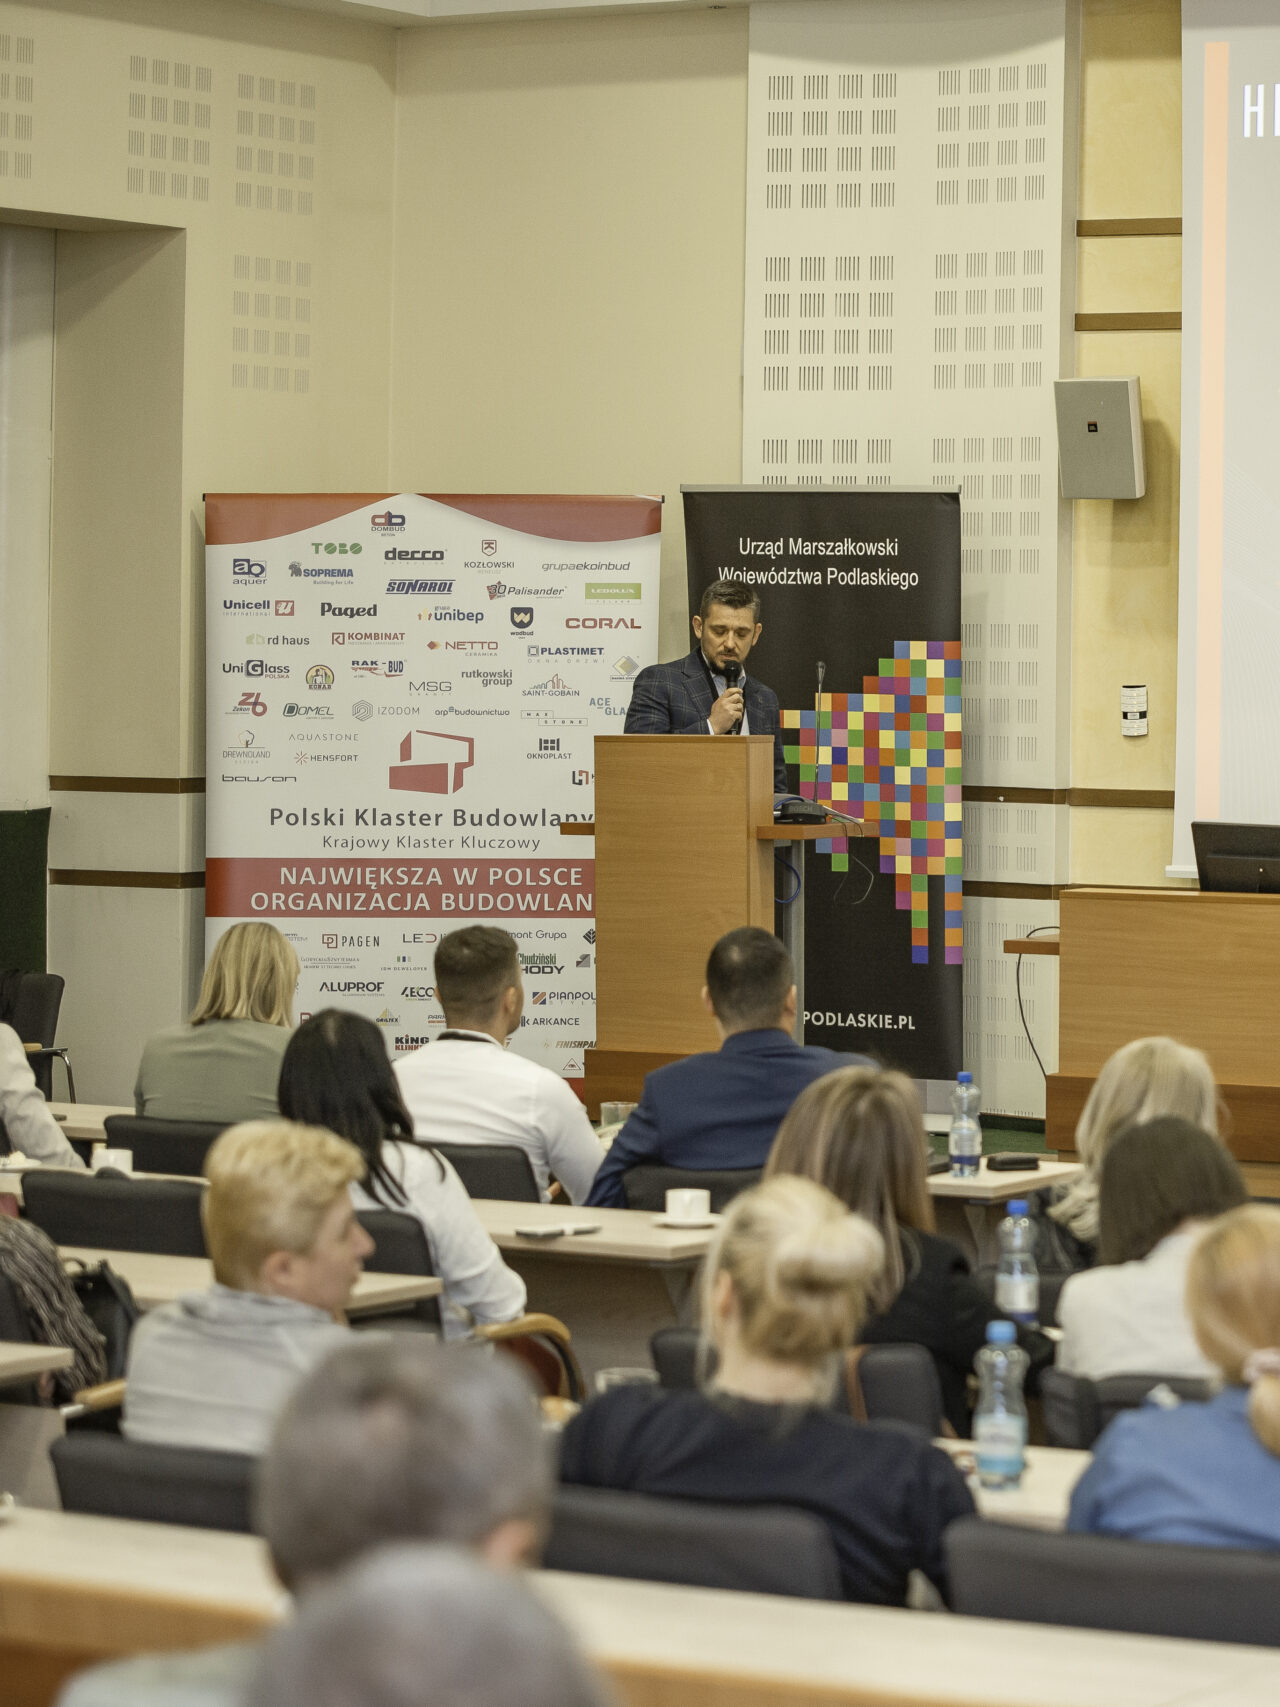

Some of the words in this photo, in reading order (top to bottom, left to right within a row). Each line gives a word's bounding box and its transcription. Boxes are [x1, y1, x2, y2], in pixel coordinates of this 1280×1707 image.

[311, 542, 363, 555] TOBO
[739, 537, 784, 559] Urząd
[789, 537, 899, 556] Marszałkowski
[464, 561, 515, 569] KOZŁOWSKI
[542, 562, 630, 572] grupaekoinbud
[303, 568, 354, 578] SOPREMA
[718, 566, 822, 585] Województwa
[827, 567, 919, 590] Podlaskiego
[386, 580, 453, 594] SONAROL
[507, 586, 564, 596] Palisander
[223, 600, 270, 609] Unicell
[320, 602, 377, 618] Paged
[434, 609, 484, 624] unibep
[565, 618, 642, 629] CORAL
[267, 635, 279, 645] rd
[282, 635, 310, 645] haus
[348, 632, 405, 640] KOMBINAT
[445, 641, 498, 650] NETTO
[541, 647, 604, 656] PLASTIMET
[222, 660, 290, 677] UniGlass
[388, 660, 404, 673] BUD
[461, 669, 513, 679] rutkowski
[409, 681, 452, 692] MSG
[482, 678, 513, 687] group
[589, 698, 611, 706] ACE
[283, 703, 334, 717] DOMEL
[377, 707, 420, 715] IZODOM
[605, 707, 627, 716] GLA
[289, 733, 359, 741] AQUASTONE
[222, 750, 271, 759] DREWNOLAND
[526, 752, 572, 760] OKNOPLAST
[269, 807, 345, 827] Polski
[355, 807, 443, 827] Klaster
[323, 835, 391, 852] Krajowy
[397, 835, 455, 849] Klaster
[461, 836, 541, 852] Kluczowy
[280, 867, 443, 889] NAJWIĘKSZA
[453, 867, 479, 886] W
[489, 867, 583, 886] POLSCE
[251, 892, 431, 912] ORGANIZACJA
[441, 892, 593, 912] BUDOWLAN
[402, 933, 437, 943] LED
[535, 930, 567, 941] Grupa
[341, 936, 380, 947] PAGEN
[518, 953, 557, 965] Chudziński
[522, 965, 565, 974] HODY
[319, 982, 385, 992] ALUPROF
[549, 991, 596, 1000] PIANPOL
[532, 1017, 580, 1026] ARKANCE
[803, 1011, 916, 1030] PODLASKIE.PL
